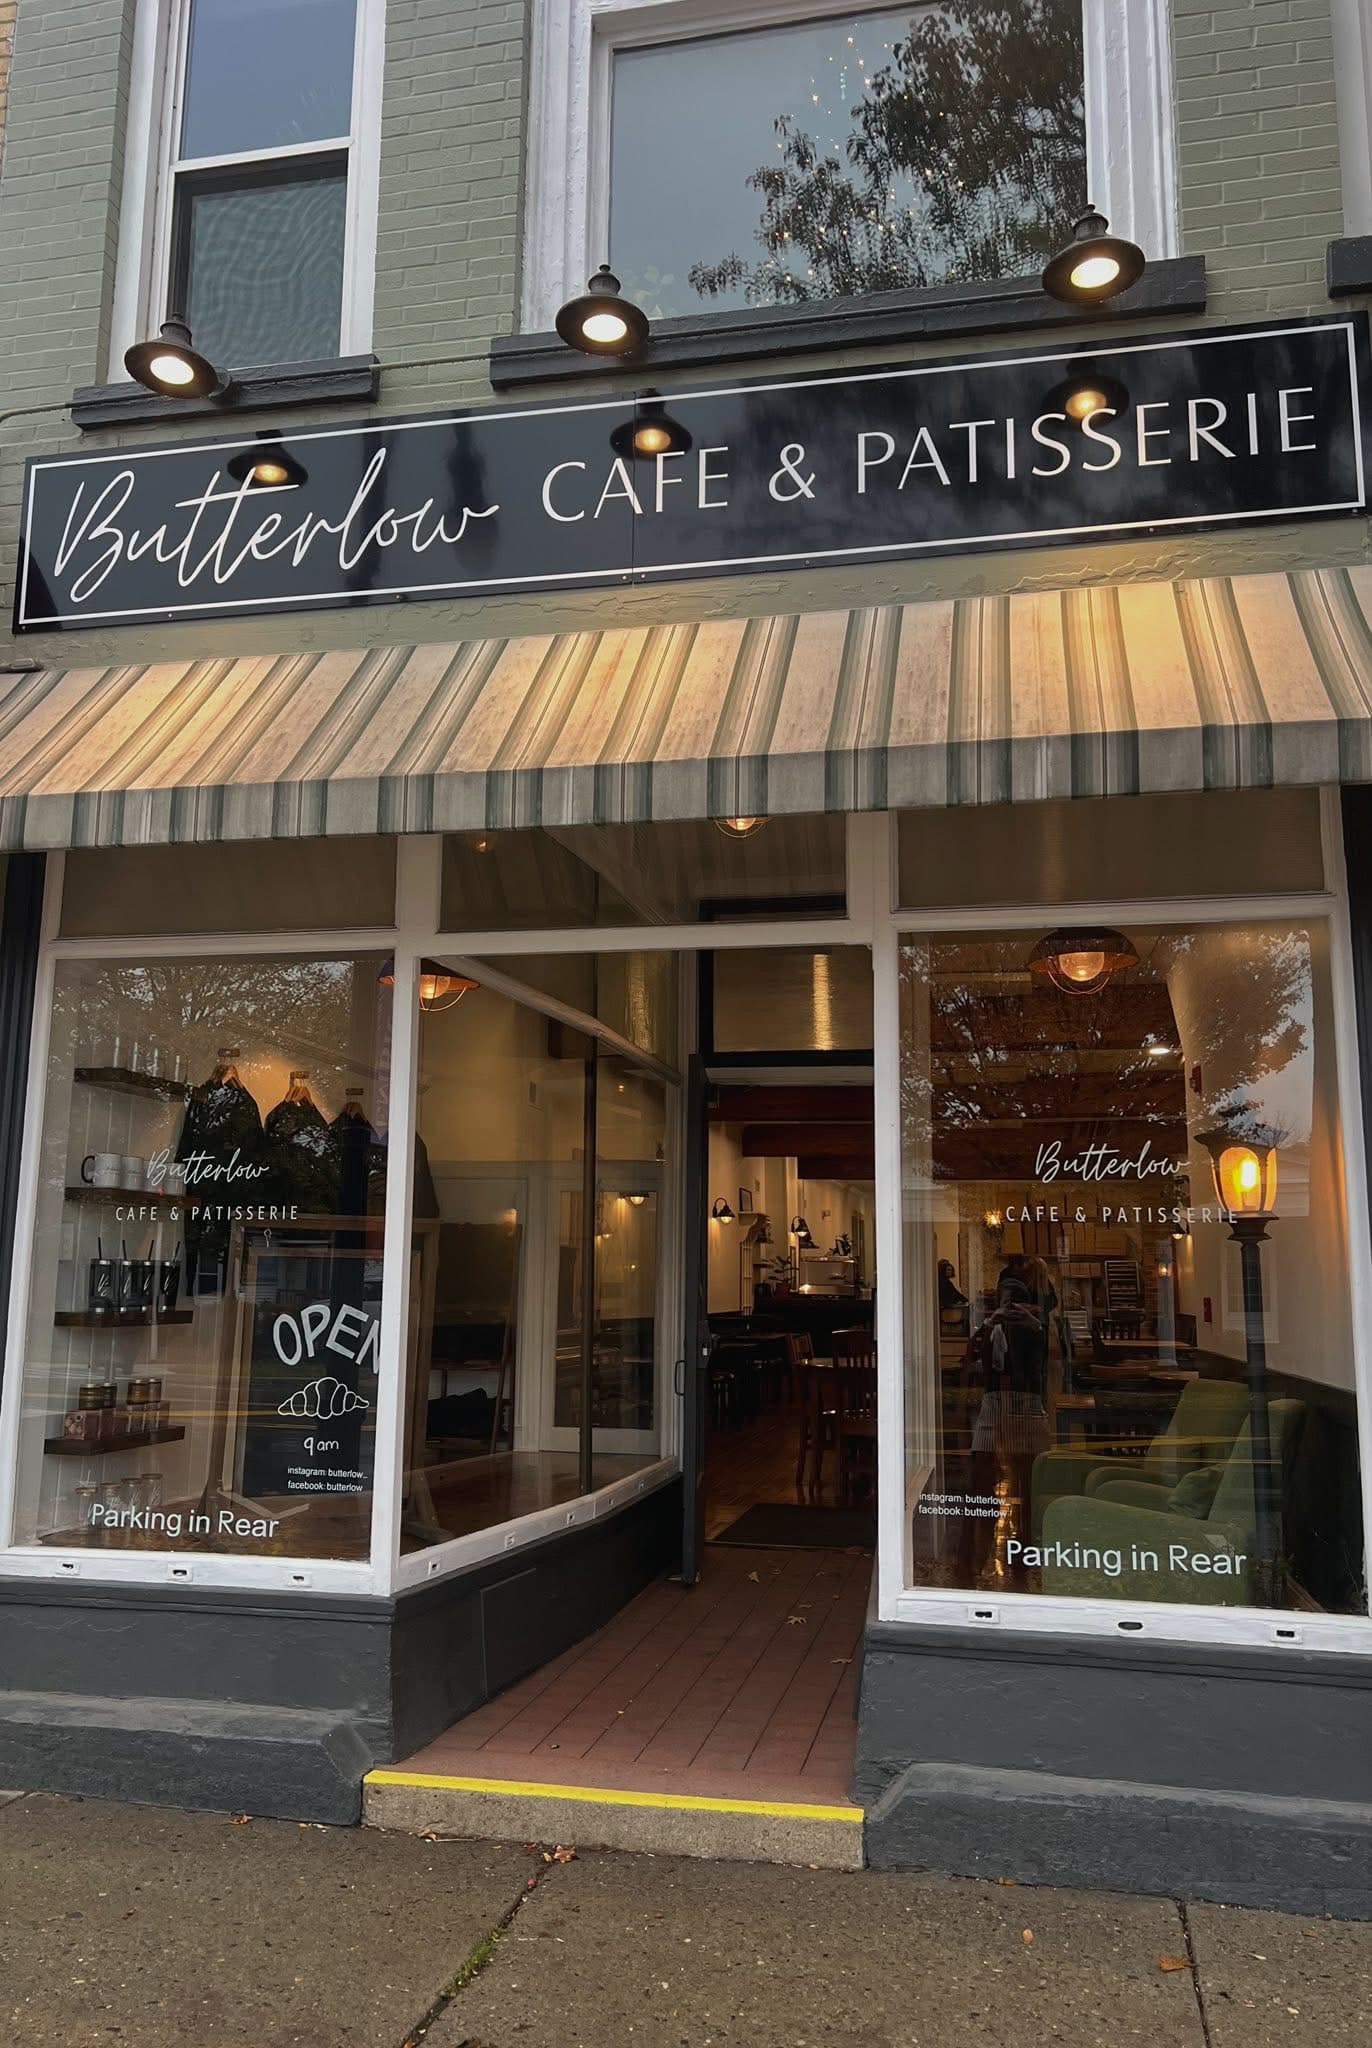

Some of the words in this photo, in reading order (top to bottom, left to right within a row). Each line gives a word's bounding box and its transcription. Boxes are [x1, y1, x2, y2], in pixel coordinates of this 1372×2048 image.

[54, 447, 500, 602] Butterlow
[541, 446, 729, 522] CAFE
[768, 443, 816, 502] &
[857, 386, 1317, 494] PATISSERIE
[147, 1148, 269, 1186] Butterlow
[1035, 1140, 1190, 1183] Butterlow
[115, 1206, 158, 1221] CAFE
[170, 1206, 179, 1221] &
[191, 1205, 298, 1221] PATISSERIE
[1006, 1206, 1059, 1222] CAFE
[1075, 1206, 1086, 1223] &
[1103, 1207, 1238, 1223] PATISSERIE
[273, 1304, 381, 1375] OPEN
[316, 1440, 339, 1452] am
[327, 1482, 363, 1492] butterlow
[92, 1503, 181, 1537] Parking
[189, 1510, 209, 1533] in
[218, 1510, 279, 1538] Rear
[1006, 1540, 1122, 1576] Parking
[1132, 1544, 1159, 1571] in
[1169, 1544, 1247, 1575] Rear
